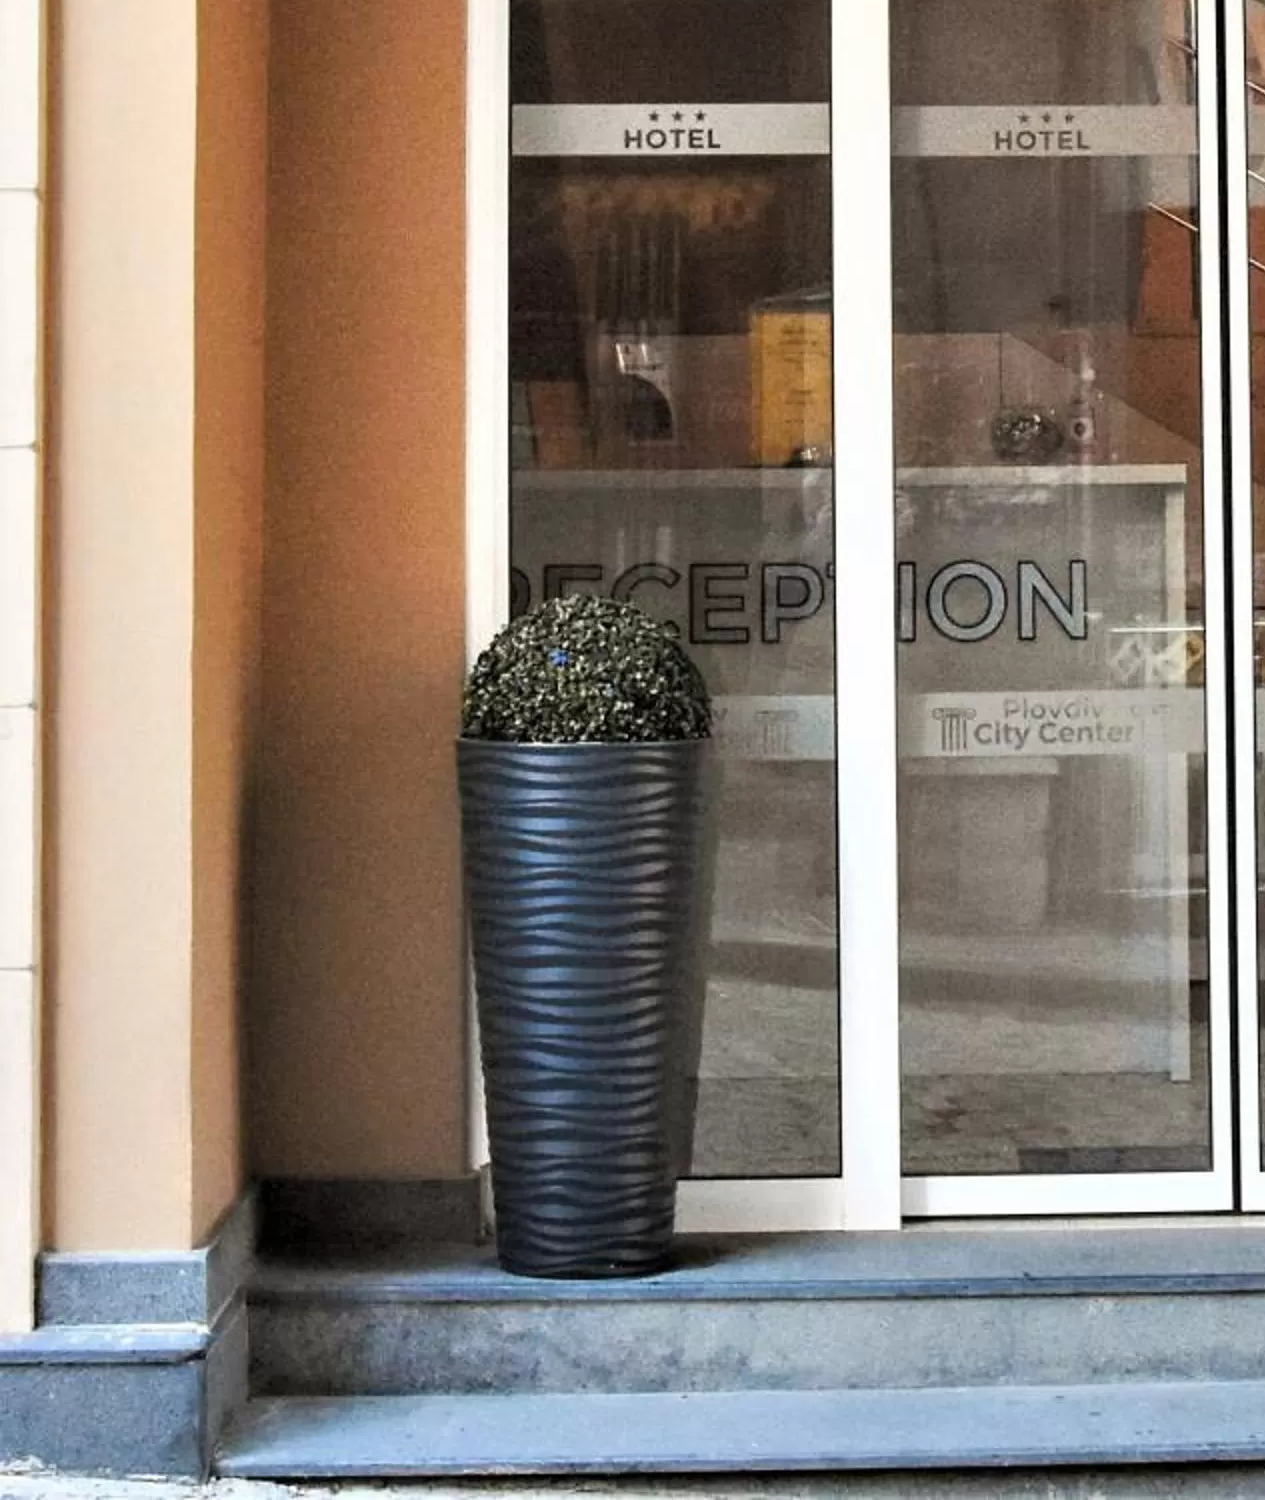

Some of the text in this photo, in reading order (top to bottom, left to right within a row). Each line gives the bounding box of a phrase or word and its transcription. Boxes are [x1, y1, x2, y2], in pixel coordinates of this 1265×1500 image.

[624, 129, 721, 149] HOTEL
[995, 131, 1091, 150] HOTEL
[1003, 695, 1101, 719] Plovdiv
[974, 720, 1134, 750] City Center
